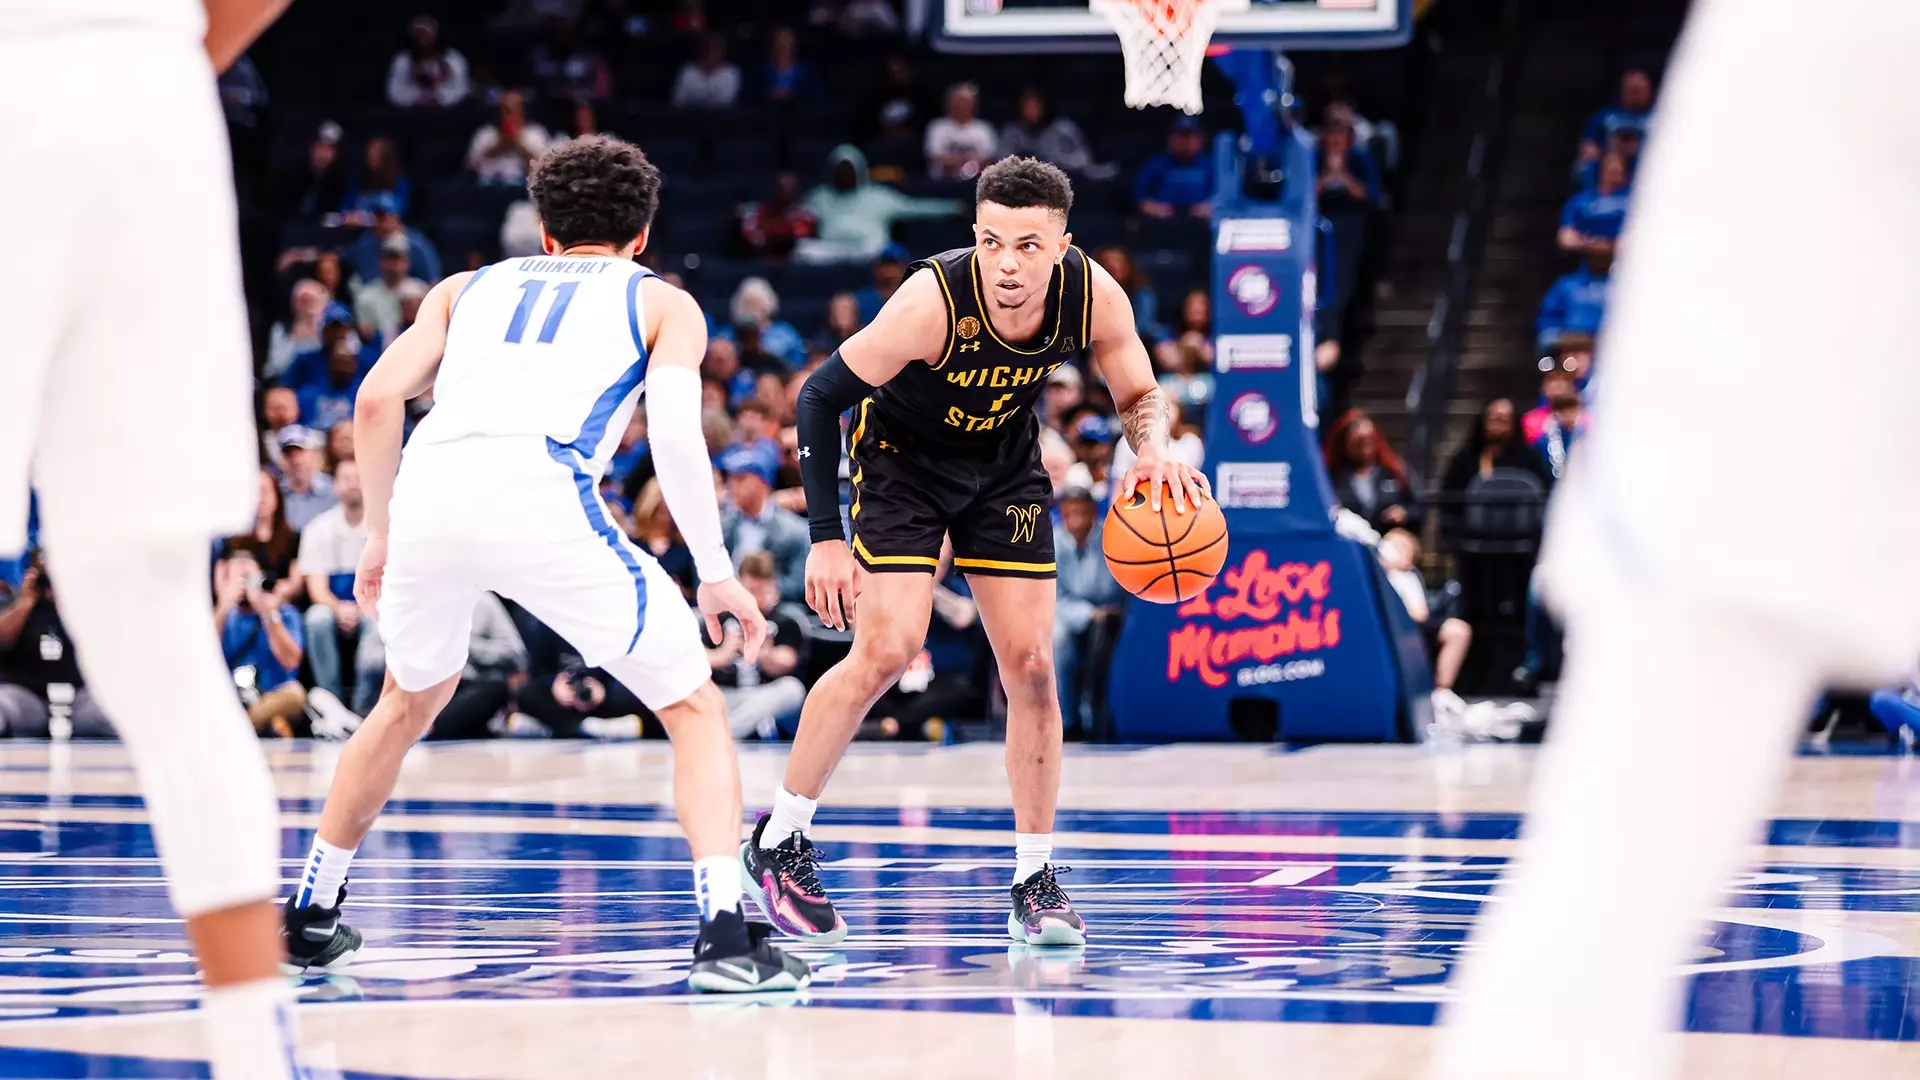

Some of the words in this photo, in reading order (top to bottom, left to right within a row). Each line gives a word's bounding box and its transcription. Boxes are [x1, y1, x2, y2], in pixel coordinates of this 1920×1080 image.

[518, 258, 613, 274] QUINERLY
[503, 278, 582, 345] 11
[946, 361, 1068, 388] WICHIT
[943, 405, 1021, 432] STAT
[1005, 503, 1042, 543] W
[1216, 548, 1332, 621] Love
[1166, 602, 1341, 688] Memphis
